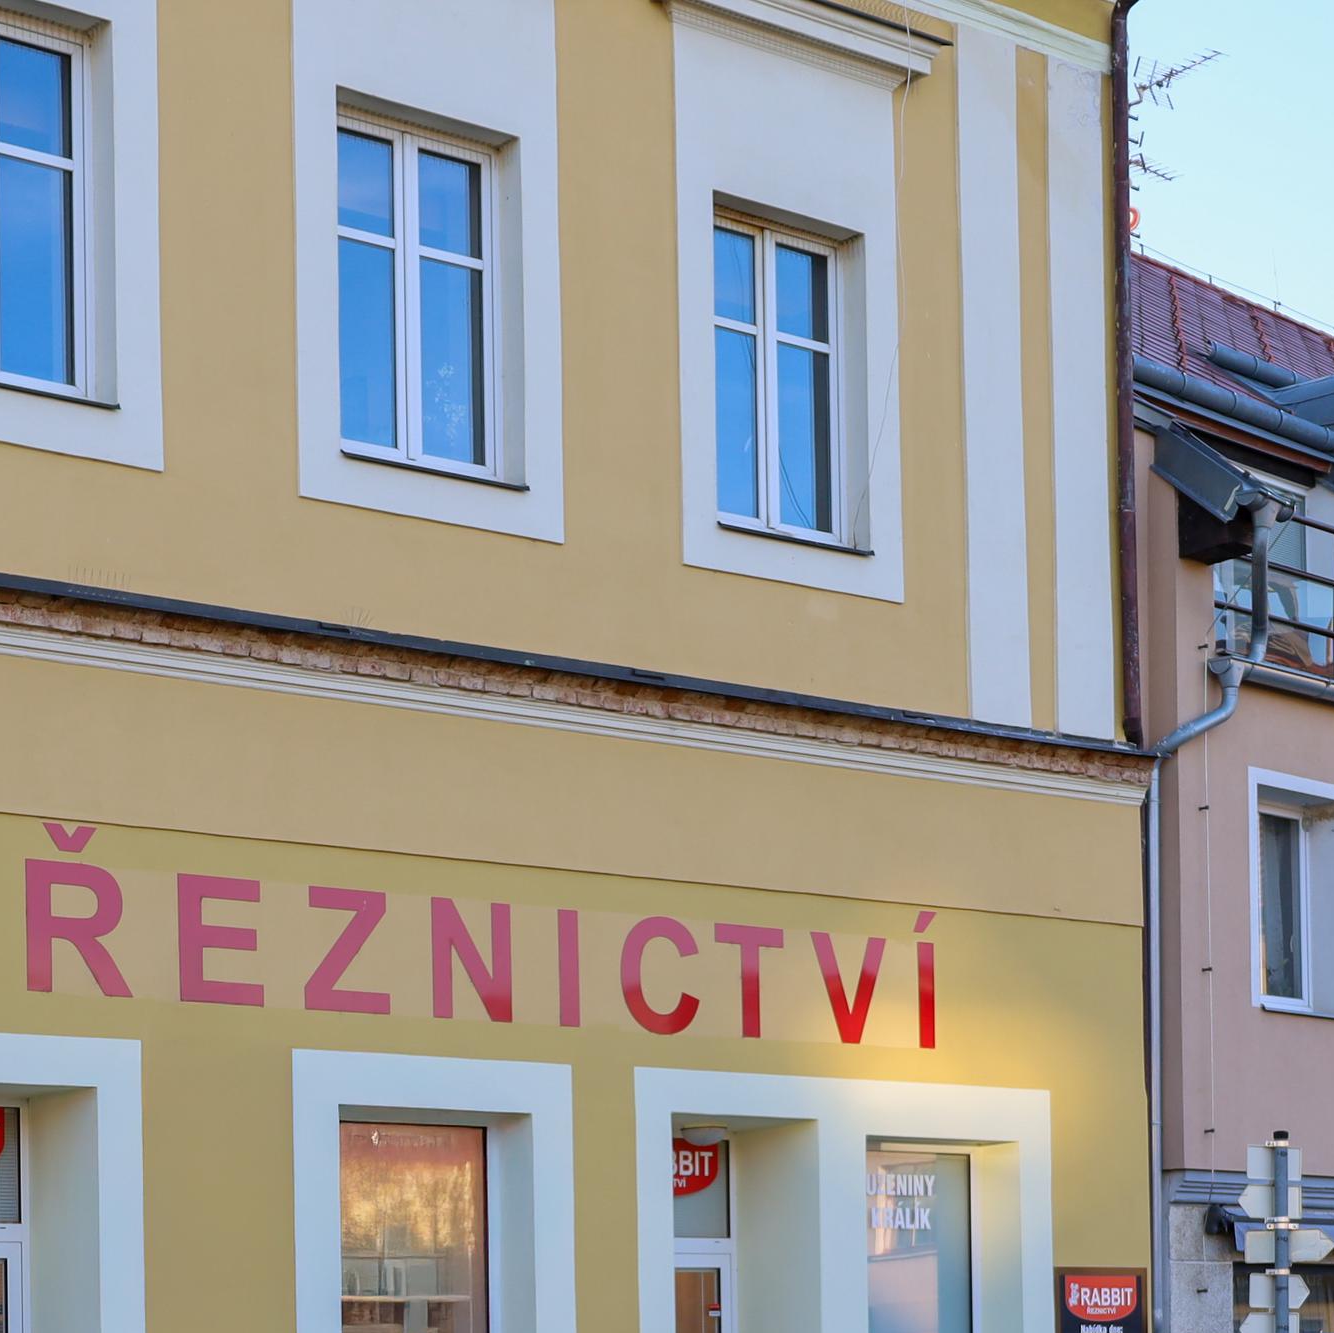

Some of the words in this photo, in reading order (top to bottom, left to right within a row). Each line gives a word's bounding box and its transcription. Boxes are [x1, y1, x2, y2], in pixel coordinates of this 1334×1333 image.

[24, 821, 938, 1050] ŘEZNICTVÍ
[866, 1174, 935, 1197] UZENINY
[871, 1200, 932, 1230] KRÁLÍK
[1080, 1287, 1133, 1306] RABBIT
